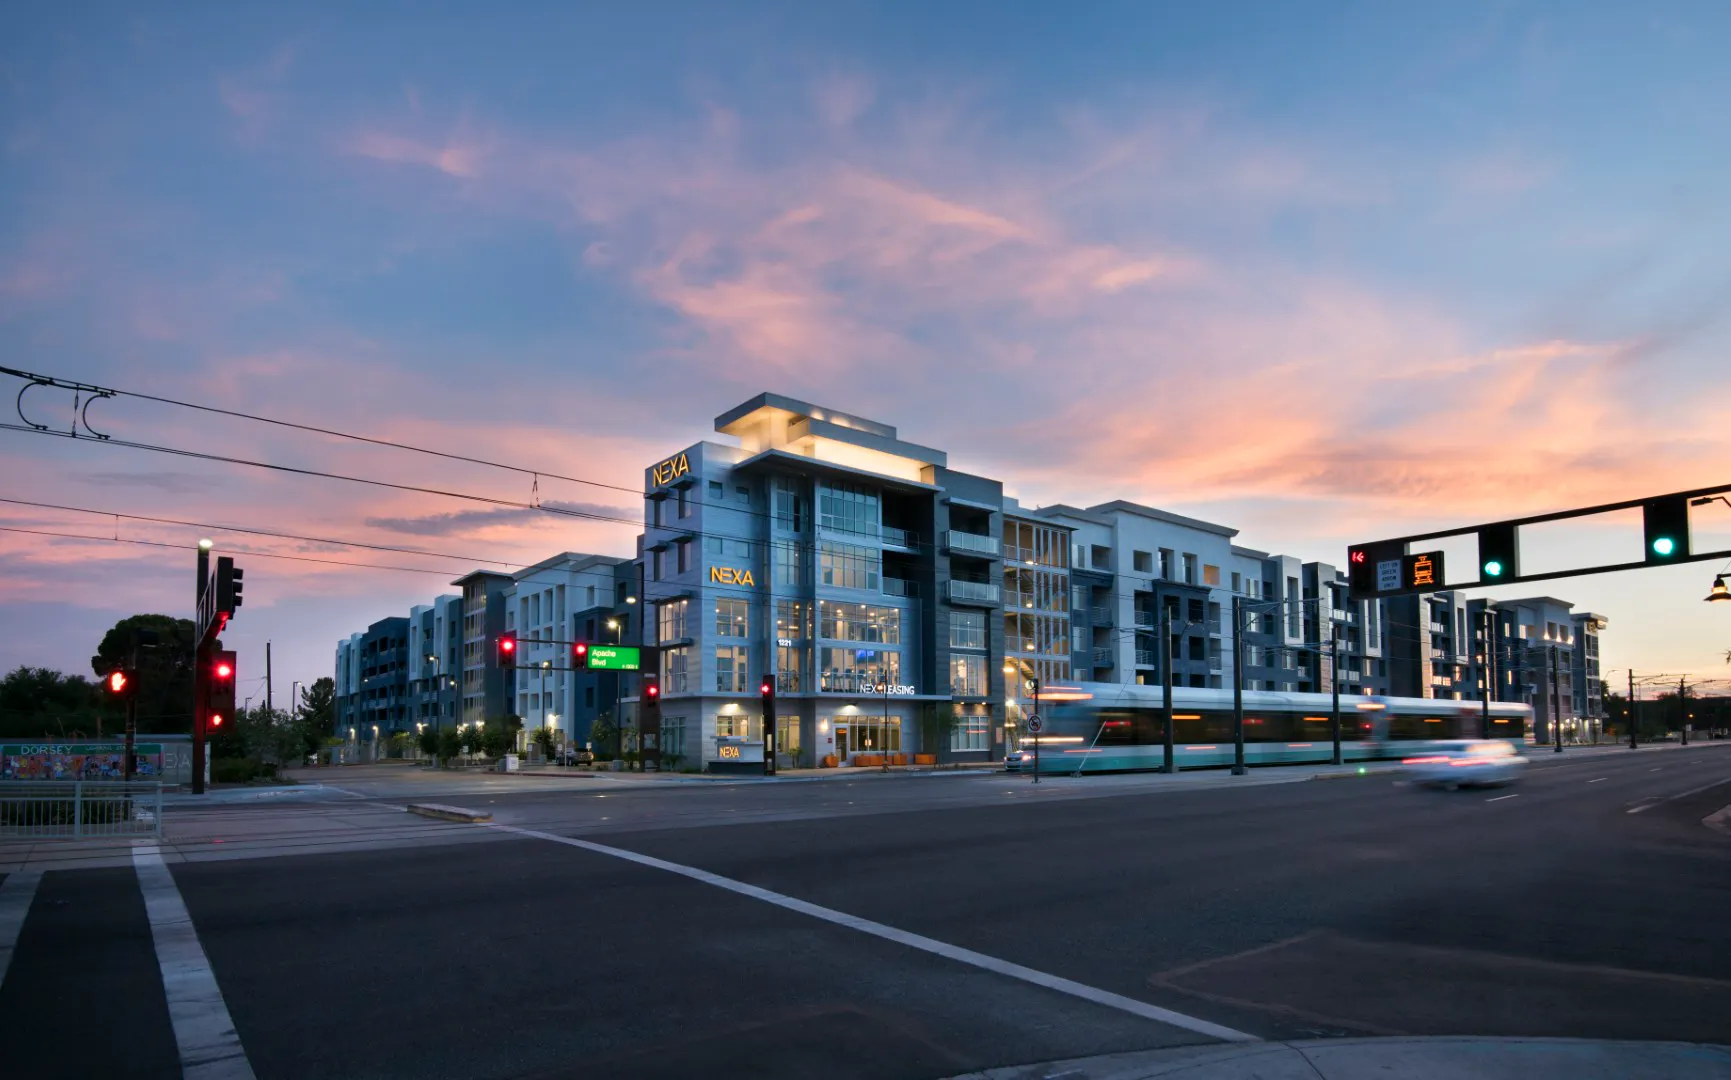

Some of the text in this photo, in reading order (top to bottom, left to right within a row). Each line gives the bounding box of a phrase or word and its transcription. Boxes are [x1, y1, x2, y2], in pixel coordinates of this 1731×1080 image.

[653, 453, 689, 488] NEXA
[711, 565, 755, 587] NEXA
[592, 649, 616, 658] Apache
[592, 658, 606, 666] Blvd
[860, 684, 882, 694] NEX
[21, 745, 72, 755] DORSEY
[720, 746, 740, 758] NEXA
